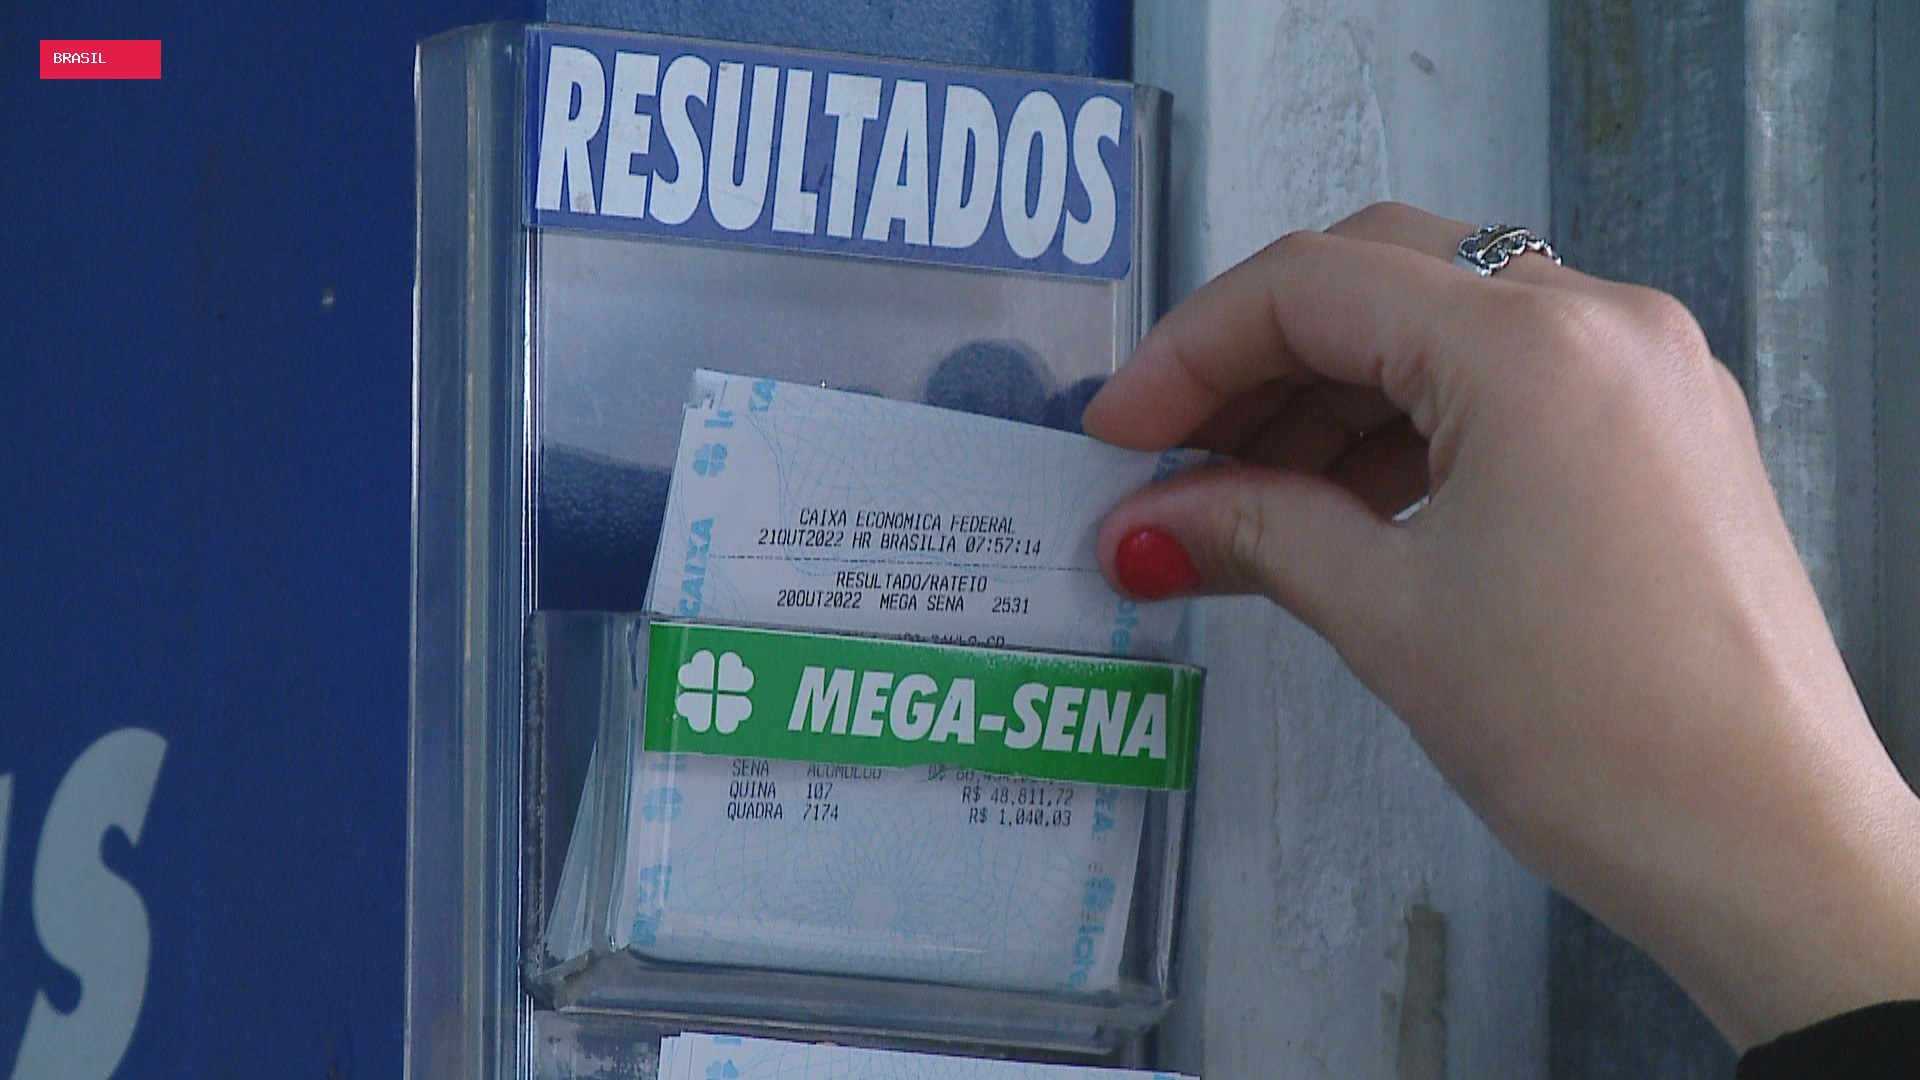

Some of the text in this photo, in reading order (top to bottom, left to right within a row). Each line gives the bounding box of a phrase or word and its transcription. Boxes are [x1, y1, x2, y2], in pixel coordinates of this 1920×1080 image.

[535, 44, 1123, 265] RESULTADOS
[799, 508, 1015, 534] CAIXA ECONOMICA FEDERAL
[851, 532, 872, 549] HR
[880, 533, 956, 553] BRASILIA
[965, 535, 1041, 556] 07:57:14
[835, 571, 988, 593] RESULTADO/RATEIO
[777, 589, 1030, 614] 20OUT2022 MEGA SENA 2531
[788, 665, 1167, 760] MEGA-SENA
[732, 758, 769, 777] SENA
[729, 780, 776, 799] QUINA
[806, 782, 834, 800] 107
[962, 785, 981, 804] R$
[727, 801, 783, 821] QUADRA
[803, 803, 839, 821] 7174
[969, 807, 988, 824] R$
